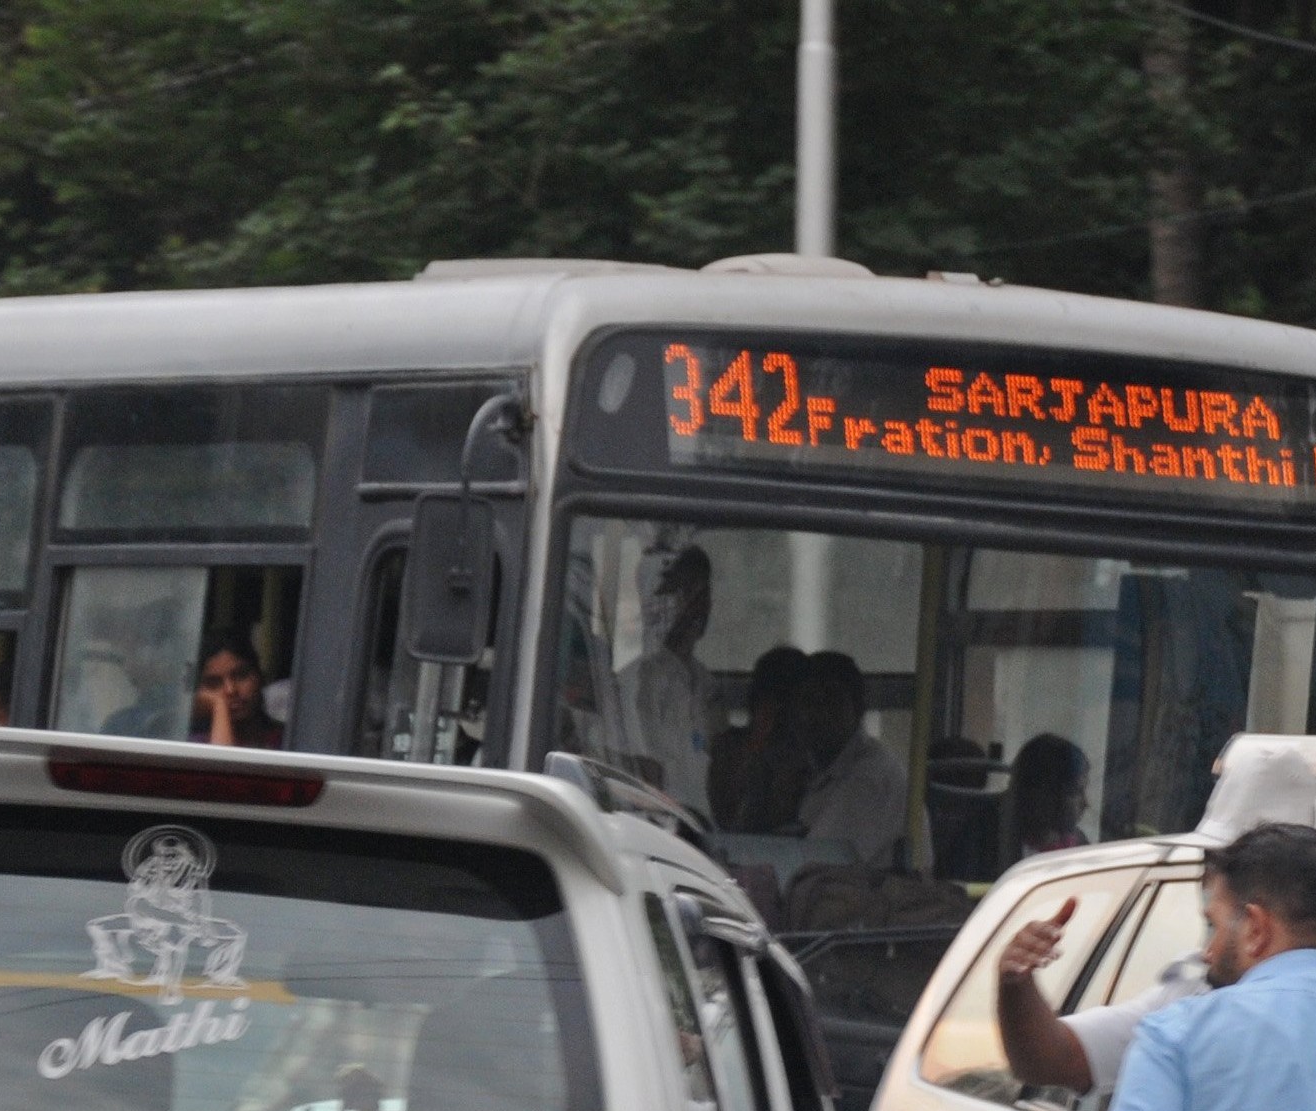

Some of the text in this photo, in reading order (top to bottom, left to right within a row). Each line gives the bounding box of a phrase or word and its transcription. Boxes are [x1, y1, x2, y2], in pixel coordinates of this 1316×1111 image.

[924, 366, 1282, 441] SARJAPURA
[1071, 425, 1296, 488] Shanthi
[36, 996, 252, 1080] Mathi
